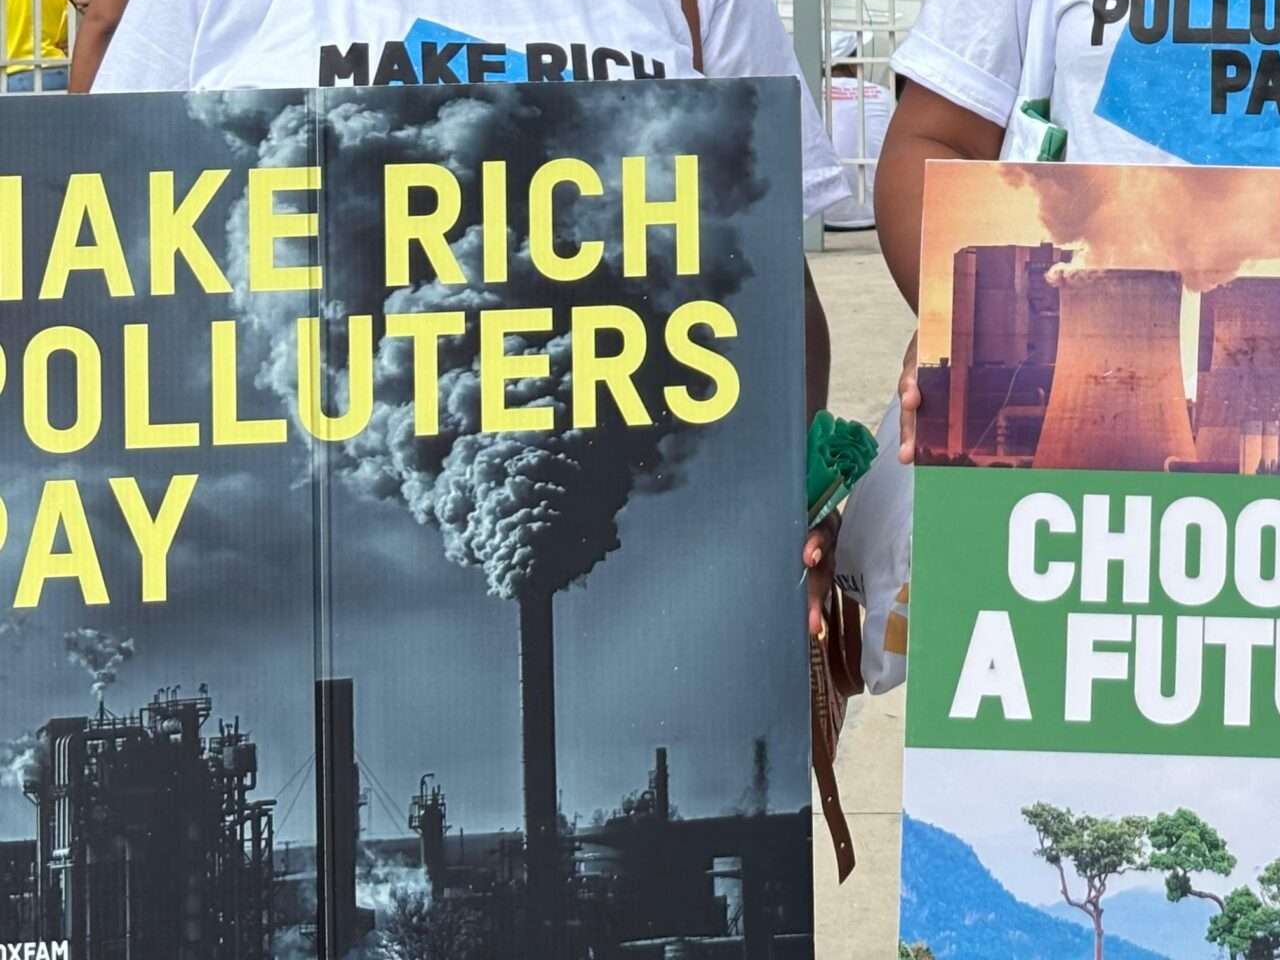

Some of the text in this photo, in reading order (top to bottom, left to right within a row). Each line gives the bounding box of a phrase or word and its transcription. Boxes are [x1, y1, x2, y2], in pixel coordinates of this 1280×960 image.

[319, 41, 666, 87] MAKE RICH
[384, 154, 700, 287] RICH
[0, 300, 741, 455] OLLUTERS
[0, 474, 199, 609] AY
[948, 609, 1034, 721] A
